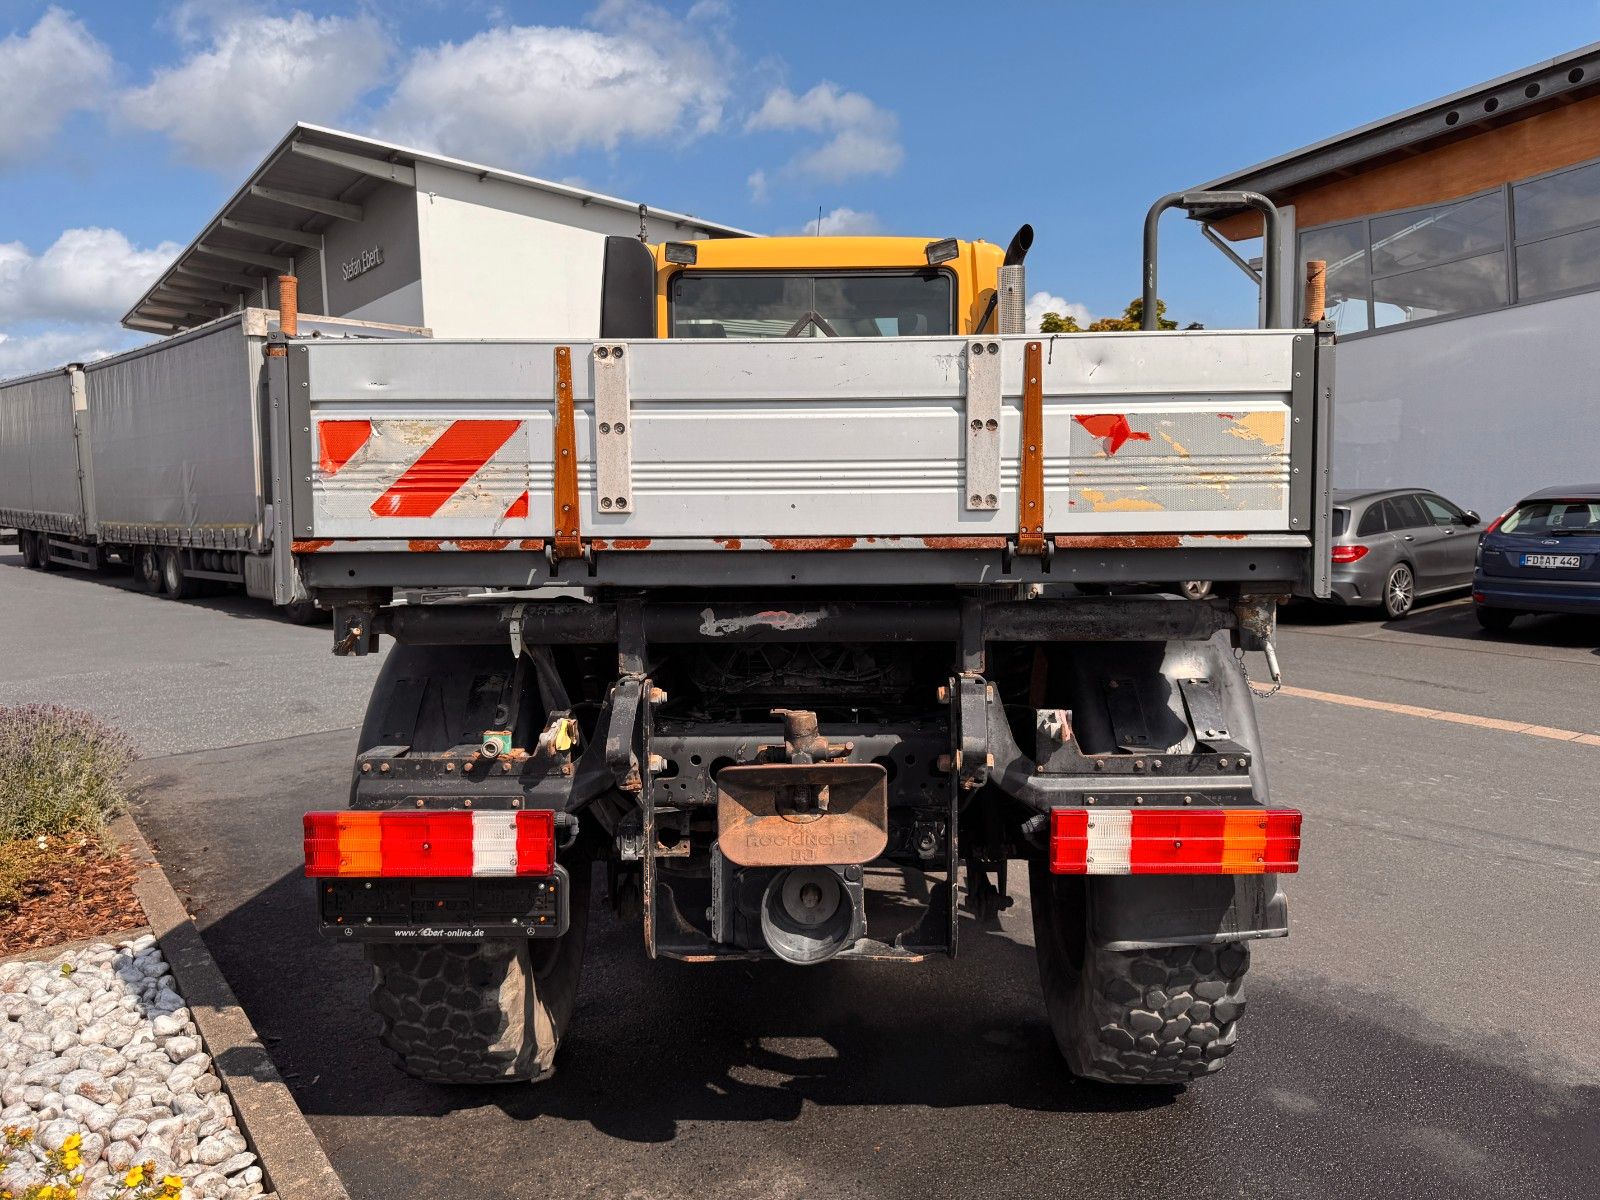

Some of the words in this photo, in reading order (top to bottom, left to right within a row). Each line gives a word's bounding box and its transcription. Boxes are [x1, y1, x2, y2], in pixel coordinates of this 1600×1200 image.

[342, 257, 362, 280] Stefan
[361, 245, 382, 273] Ebert
[1526, 555, 1539, 565] FD
[1545, 556, 1558, 566] AT
[1560, 557, 1579, 567] 442
[746, 834, 856, 848] ROCKINGER
